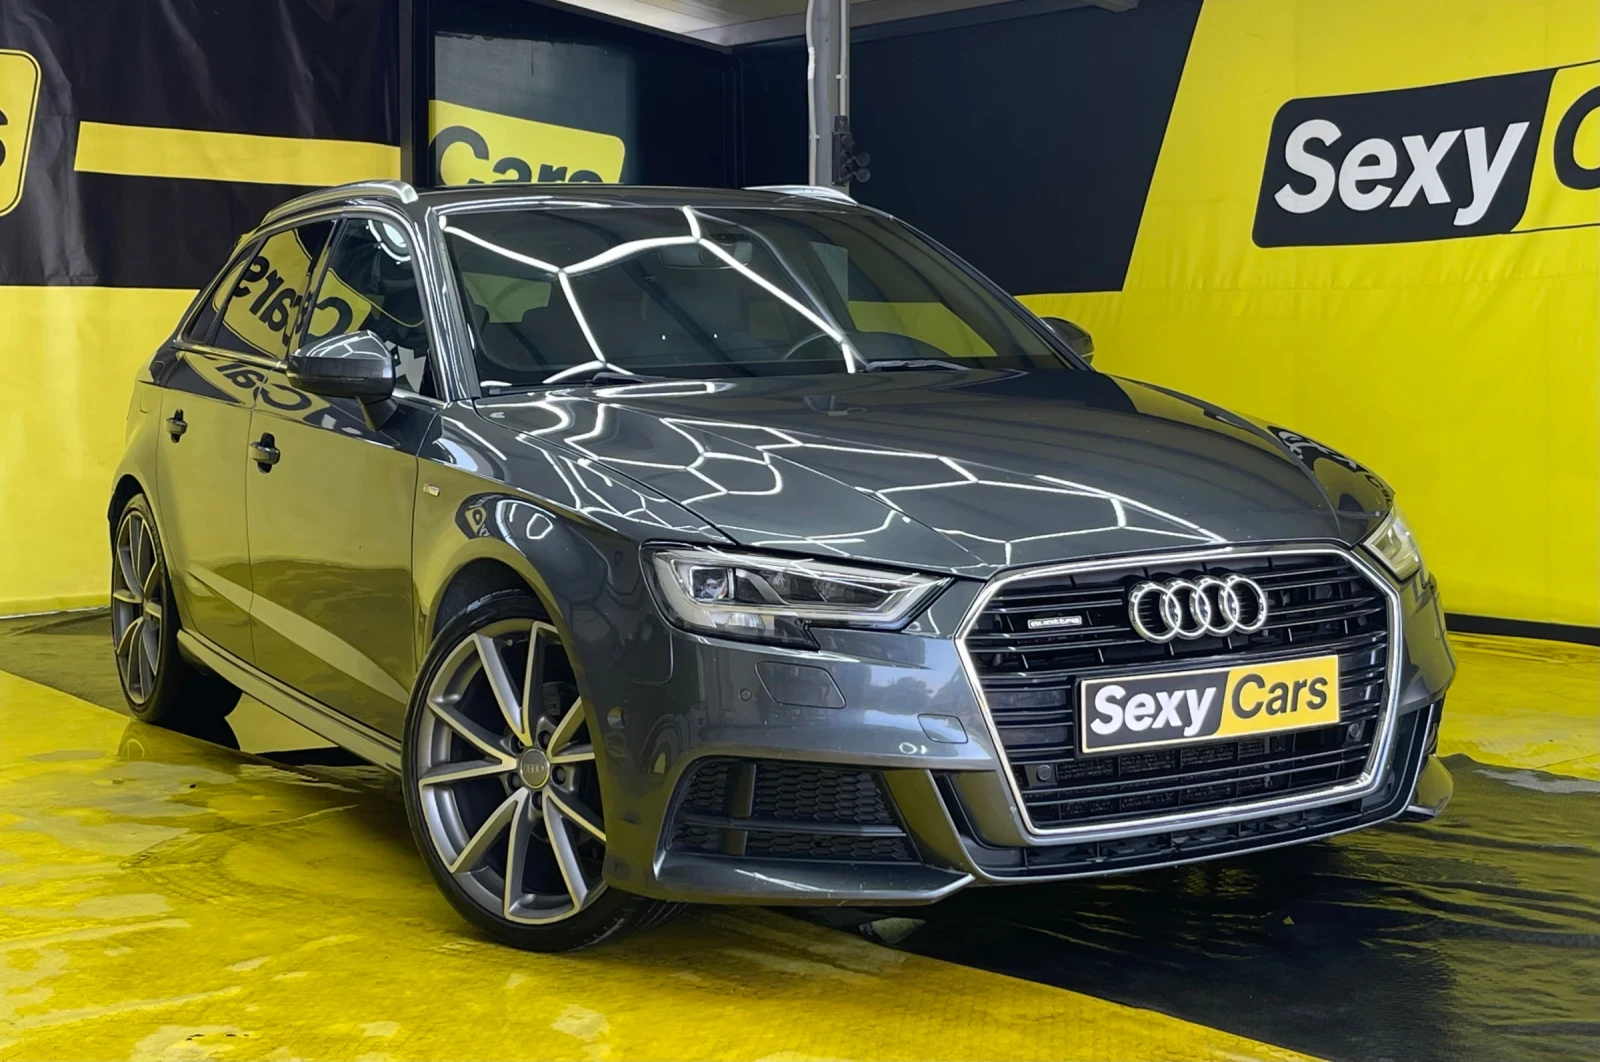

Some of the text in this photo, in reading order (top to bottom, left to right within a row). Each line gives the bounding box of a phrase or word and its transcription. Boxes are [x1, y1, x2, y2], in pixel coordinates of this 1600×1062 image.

[1274, 119, 1530, 226] Sexy
[1090, 673, 1328, 737] Sexy Cars
